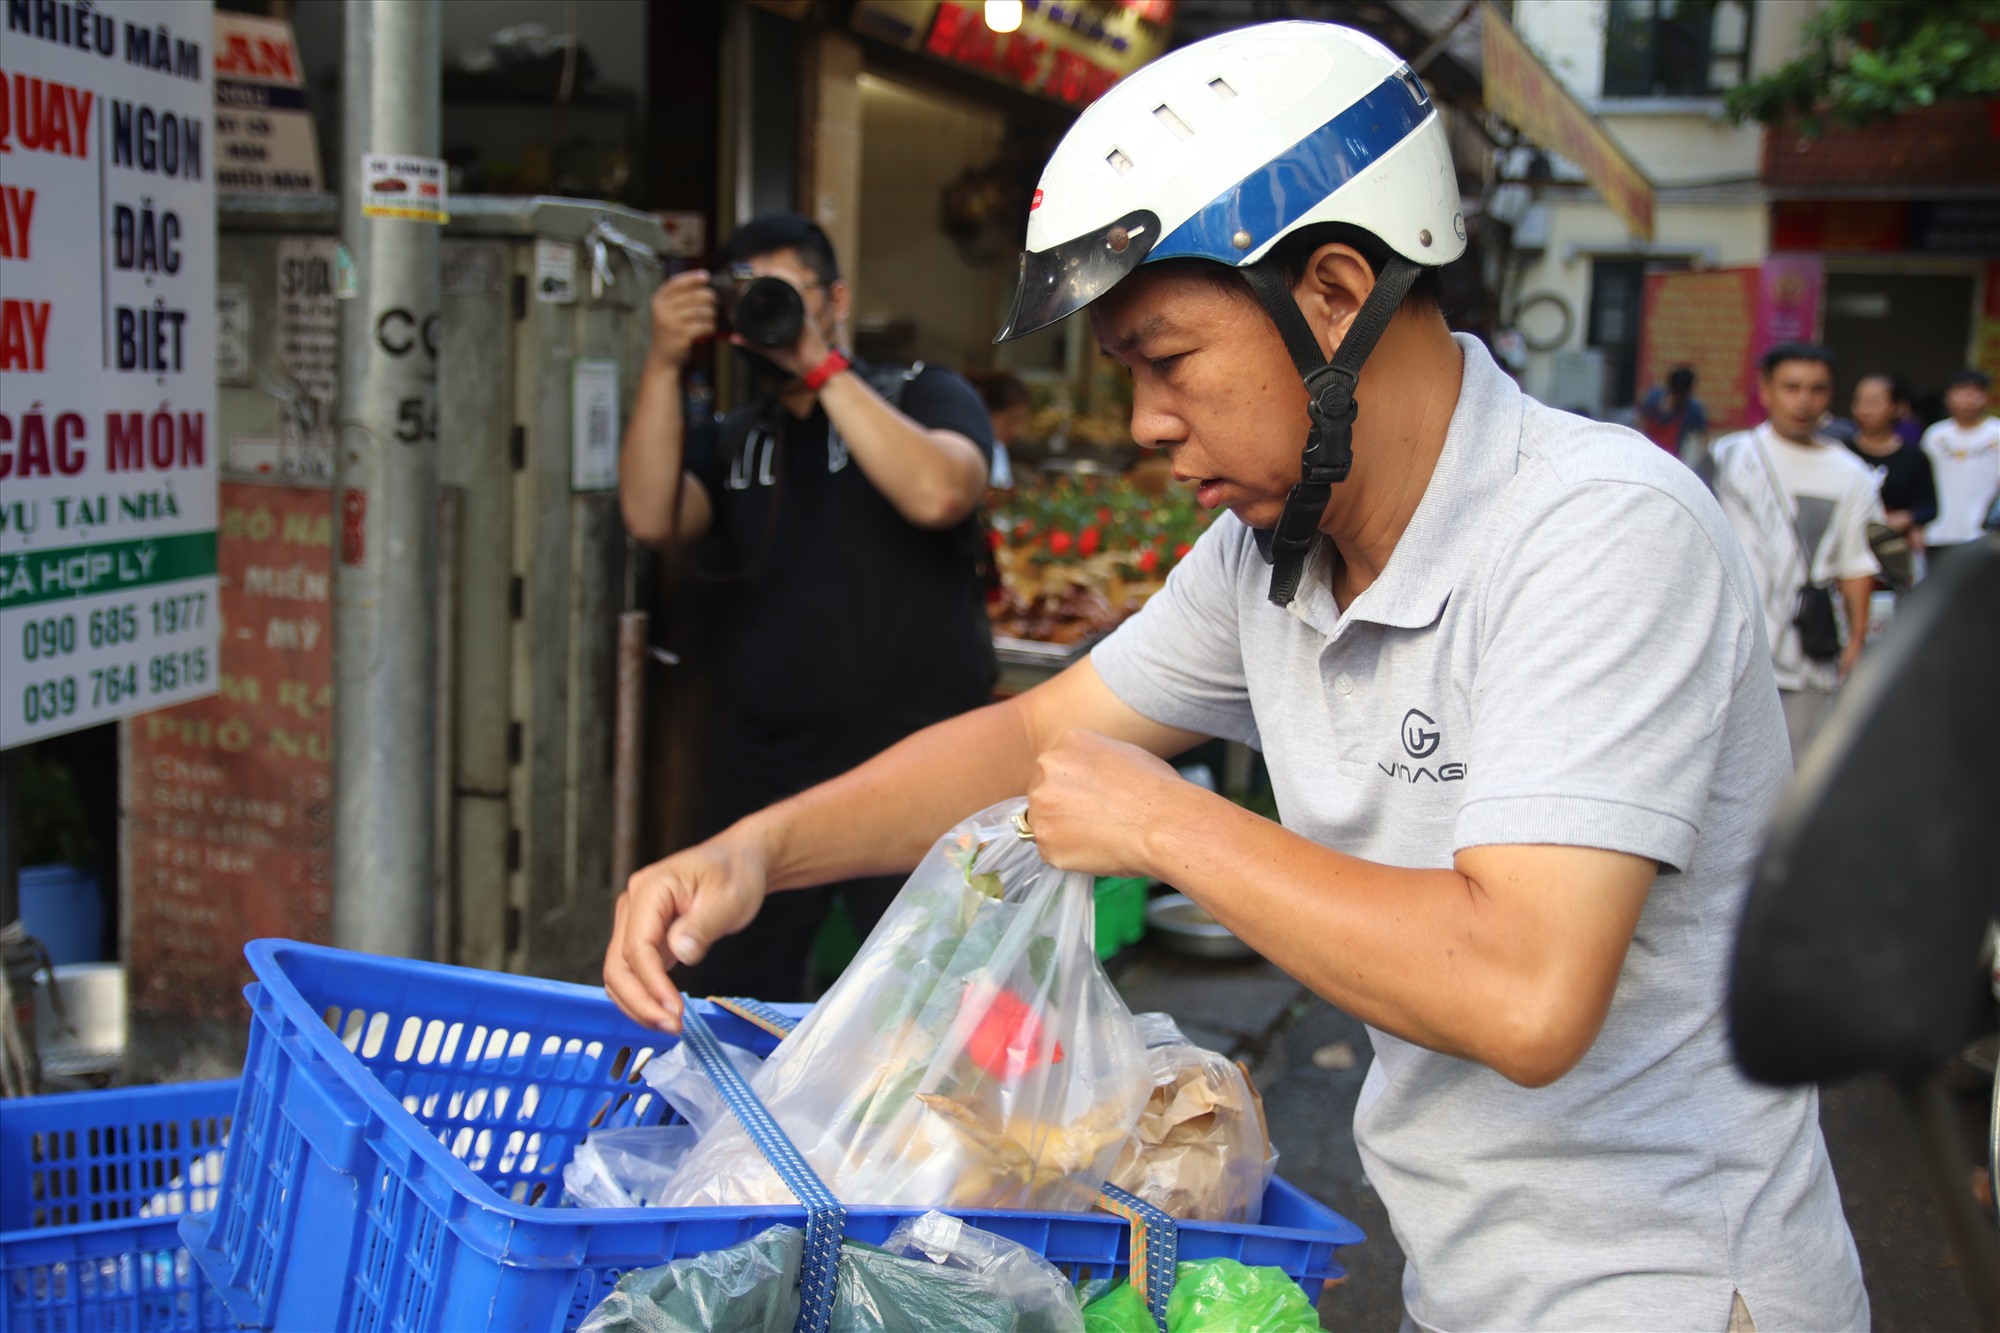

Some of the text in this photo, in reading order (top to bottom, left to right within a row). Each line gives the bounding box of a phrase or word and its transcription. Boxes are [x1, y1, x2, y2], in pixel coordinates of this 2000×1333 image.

[215, 33, 299, 84] AN
[111, 97, 203, 183] NGON
[113, 196, 184, 288] ĐẶC
[114, 296, 188, 386] BIỆT
[105, 401, 206, 474] MÓN
[51, 492, 108, 538] TẠI
[119, 480, 179, 522] NHÀ
[40, 550, 113, 598] HỢP
[118, 540, 158, 581] LÝ
[22, 593, 207, 662] 090 685 1977
[22, 650, 207, 725] 039 764 9515
